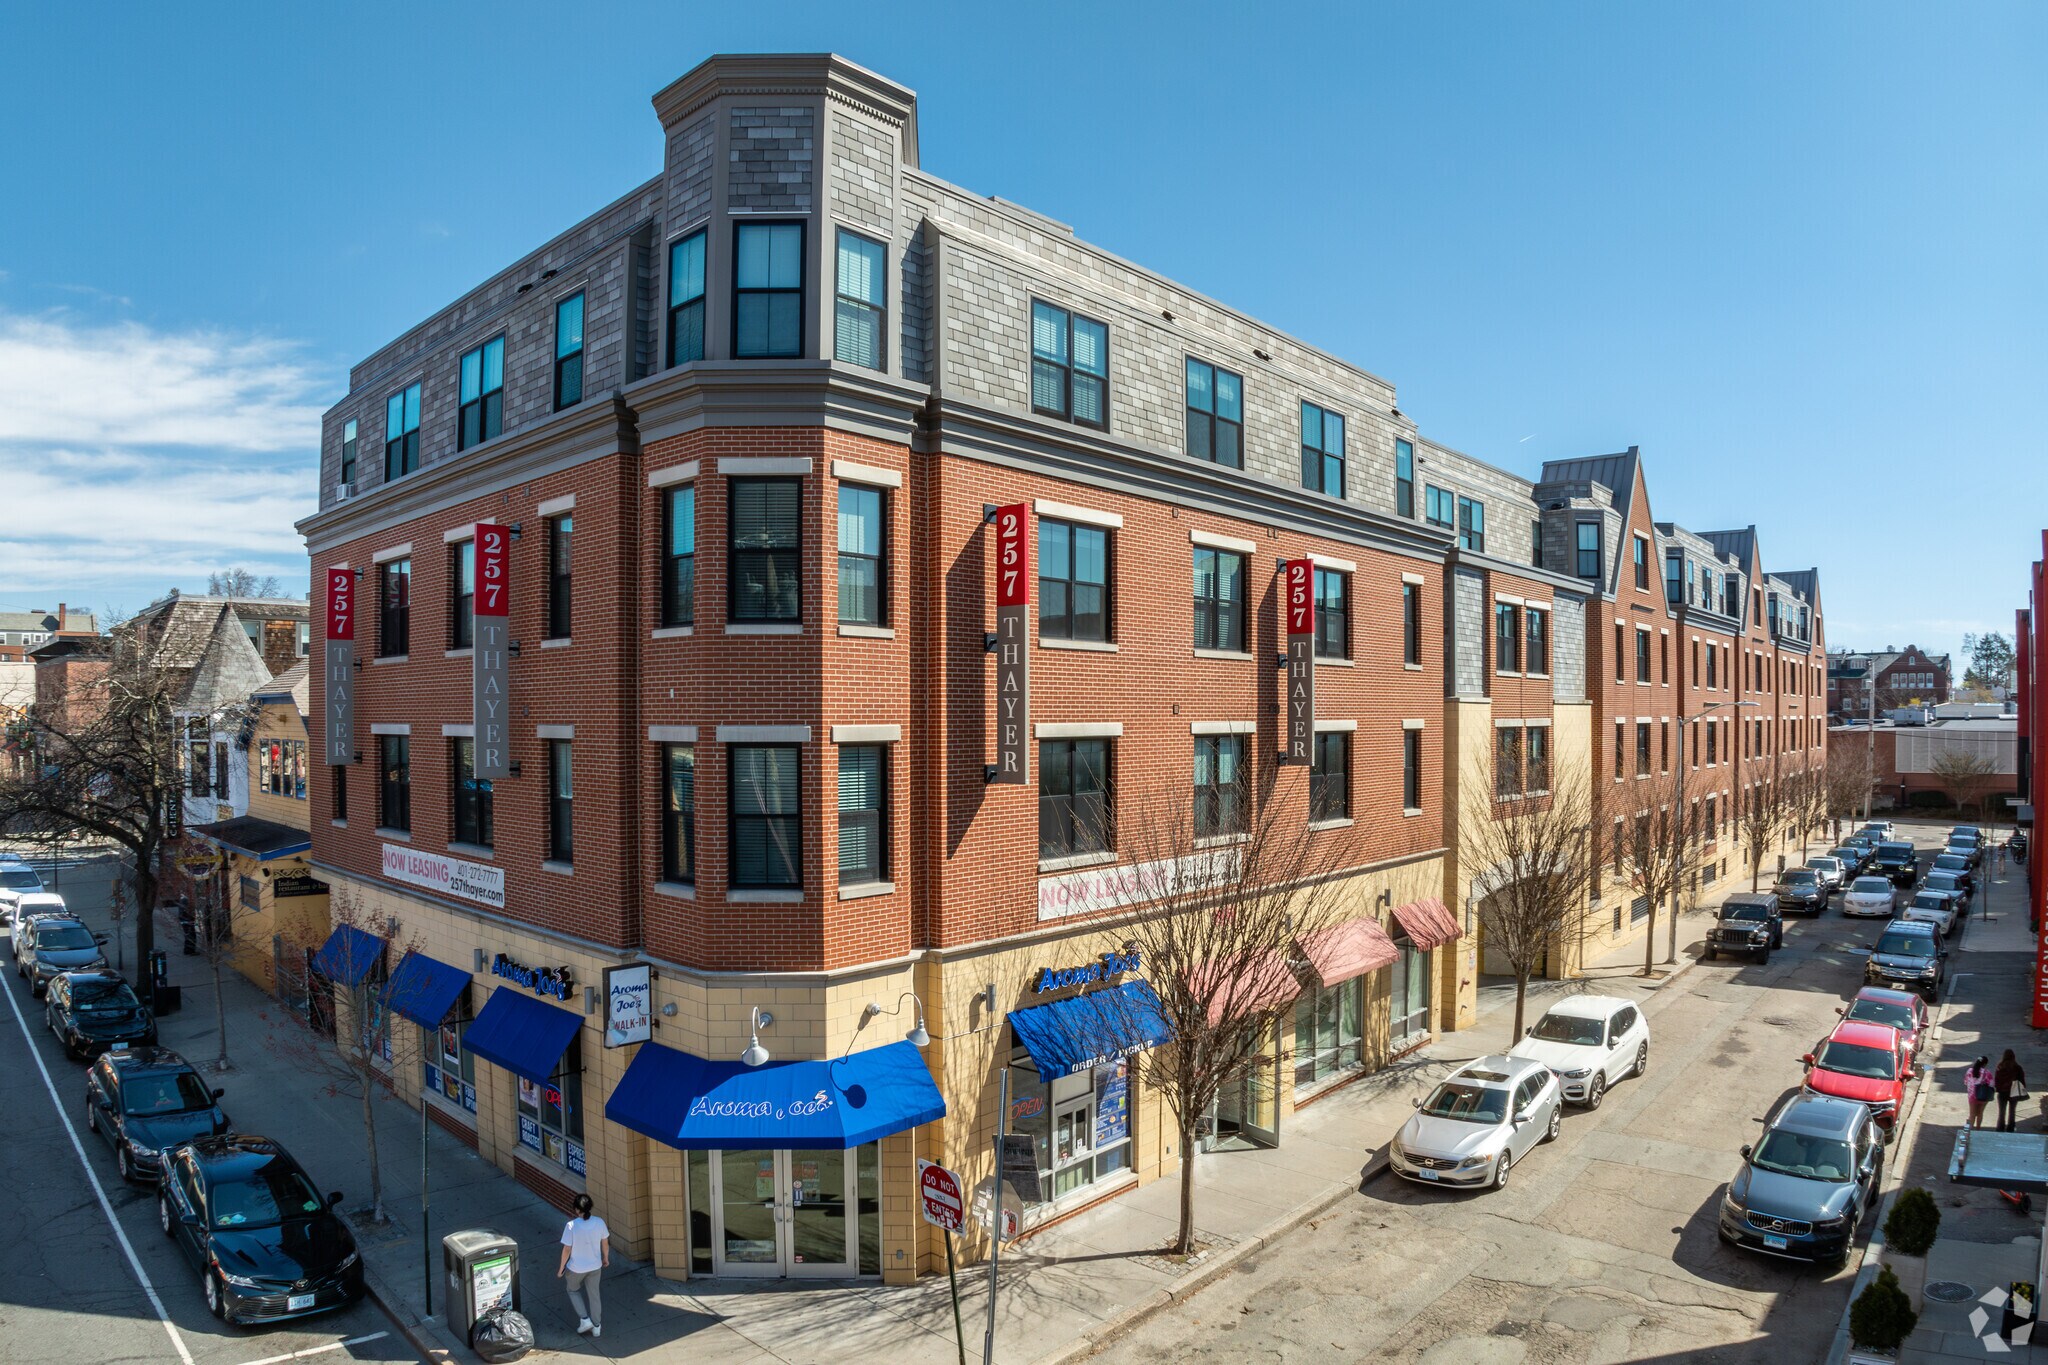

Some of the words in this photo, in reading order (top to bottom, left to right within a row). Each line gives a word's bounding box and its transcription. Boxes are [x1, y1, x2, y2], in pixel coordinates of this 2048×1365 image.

[484, 533, 501, 608] 257
[1002, 514, 1018, 597] 257
[334, 576, 348, 634] 257
[1292, 566, 1306, 627] 257
[333, 648, 347, 757] THAYER
[484, 626, 502, 768] THAYER
[1002, 616, 1019, 772] THAYER
[1292, 642, 1307, 757] THAYER
[384, 850, 406, 872] NOW
[408, 855, 449, 883] LEASING
[450, 877, 504, 903] 257thayer.com
[1040, 881, 1089, 910] NOW
[491, 953, 533, 989] Aroma
[1038, 962, 1101, 994] Aroma
[611, 982, 648, 996] Aroma
[613, 1016, 647, 1031] WALK-IN
[1071, 1055, 1107, 1073] ORDER
[1118, 1040, 1154, 1058] PICKUP
[545, 1089, 562, 1107] OPE
[690, 1096, 773, 1118] Aroma
[1011, 1097, 1043, 1120] OPEN
[521, 1117, 536, 1134] CRAFT
[572, 1159, 587, 1175] COFFE
[925, 1173, 936, 1186] DO
[940, 1179, 955, 1194] NOT
